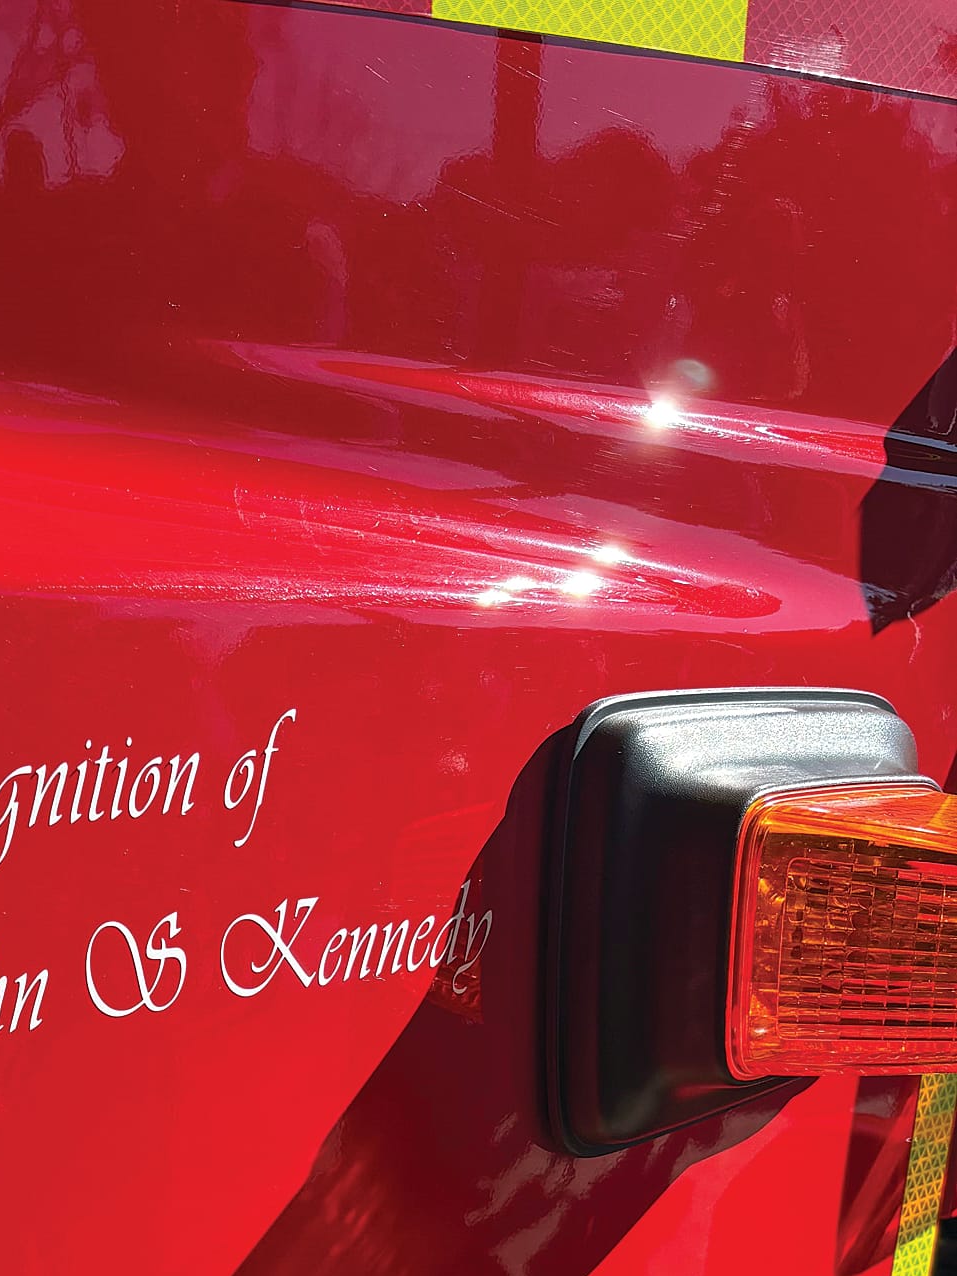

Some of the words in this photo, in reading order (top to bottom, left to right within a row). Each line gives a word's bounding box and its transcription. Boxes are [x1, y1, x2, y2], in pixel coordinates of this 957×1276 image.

[225, 709, 296, 847] of
[86, 912, 186, 1017] S
[221, 879, 492, 997] Kennedy
